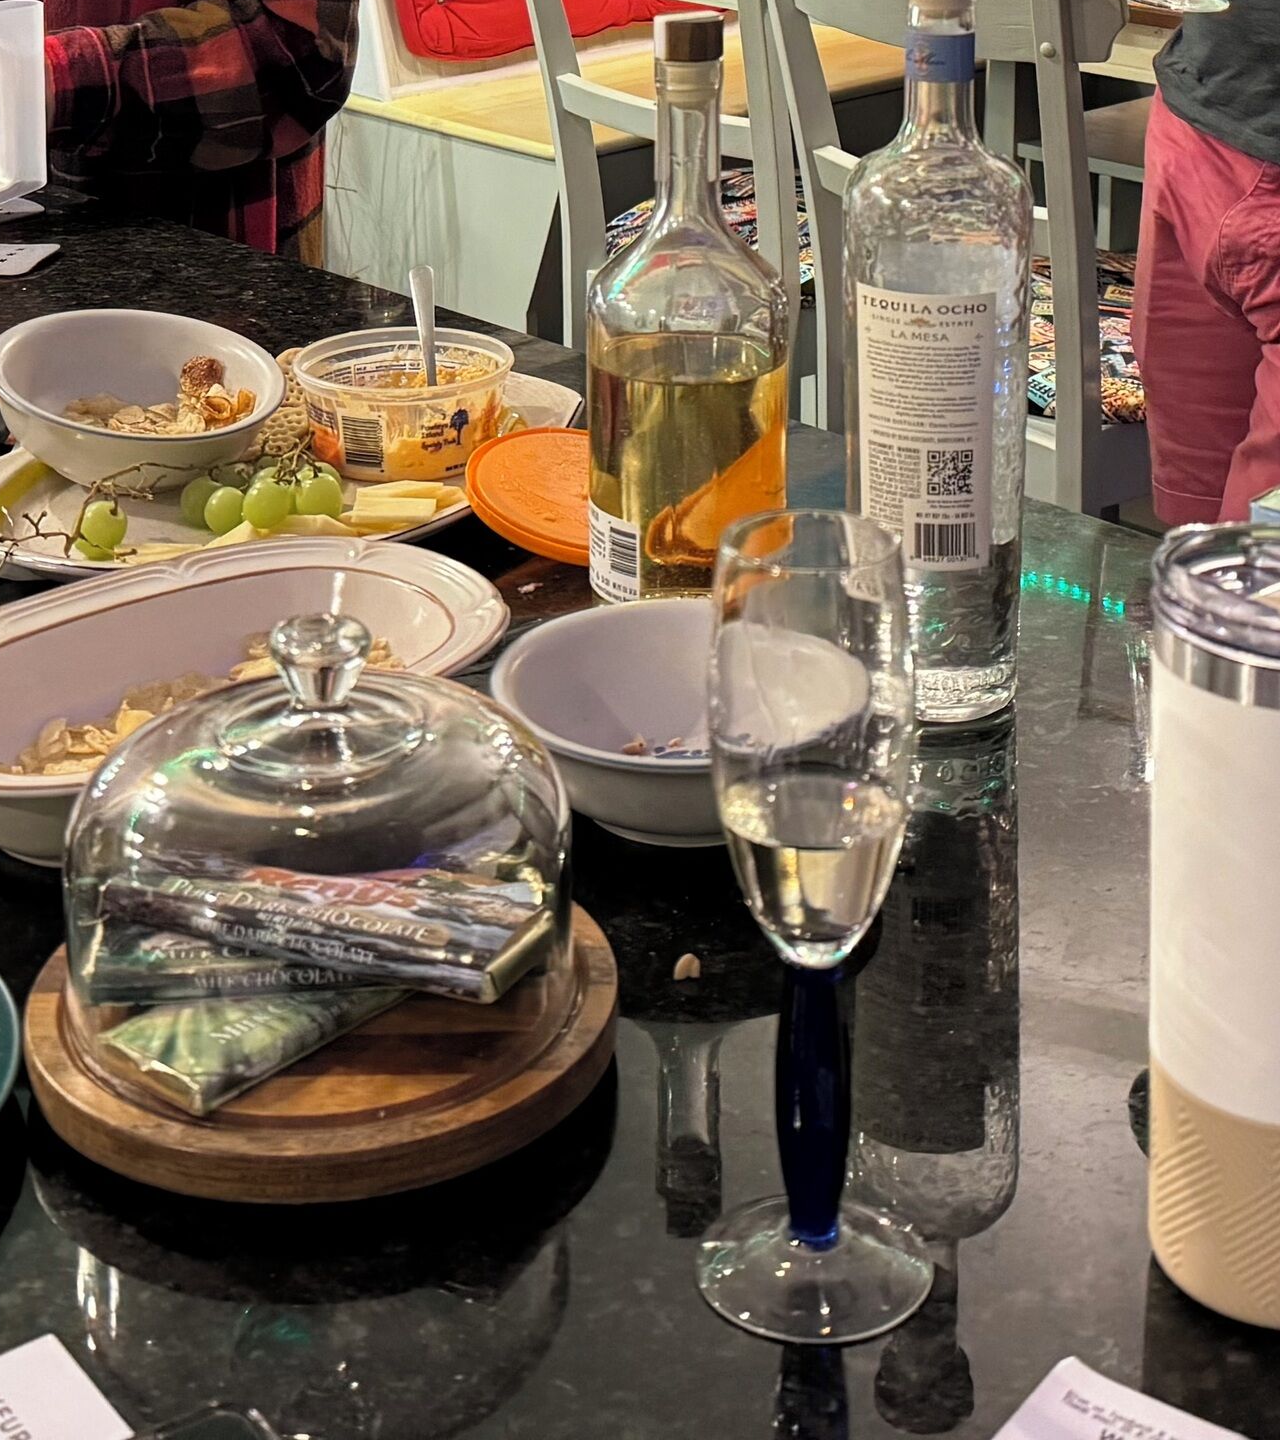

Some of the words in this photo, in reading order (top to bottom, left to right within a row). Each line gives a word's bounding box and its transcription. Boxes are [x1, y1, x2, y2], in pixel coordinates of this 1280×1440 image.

[862, 295, 932, 315] TEQUILA
[937, 303, 988, 315] OCHO
[871, 314, 901, 324] SINGLE
[891, 330, 907, 339] LA
[911, 331, 950, 342] MESA
[230, 891, 289, 913] DARK
[297, 906, 429, 941] CHOCOLATE
